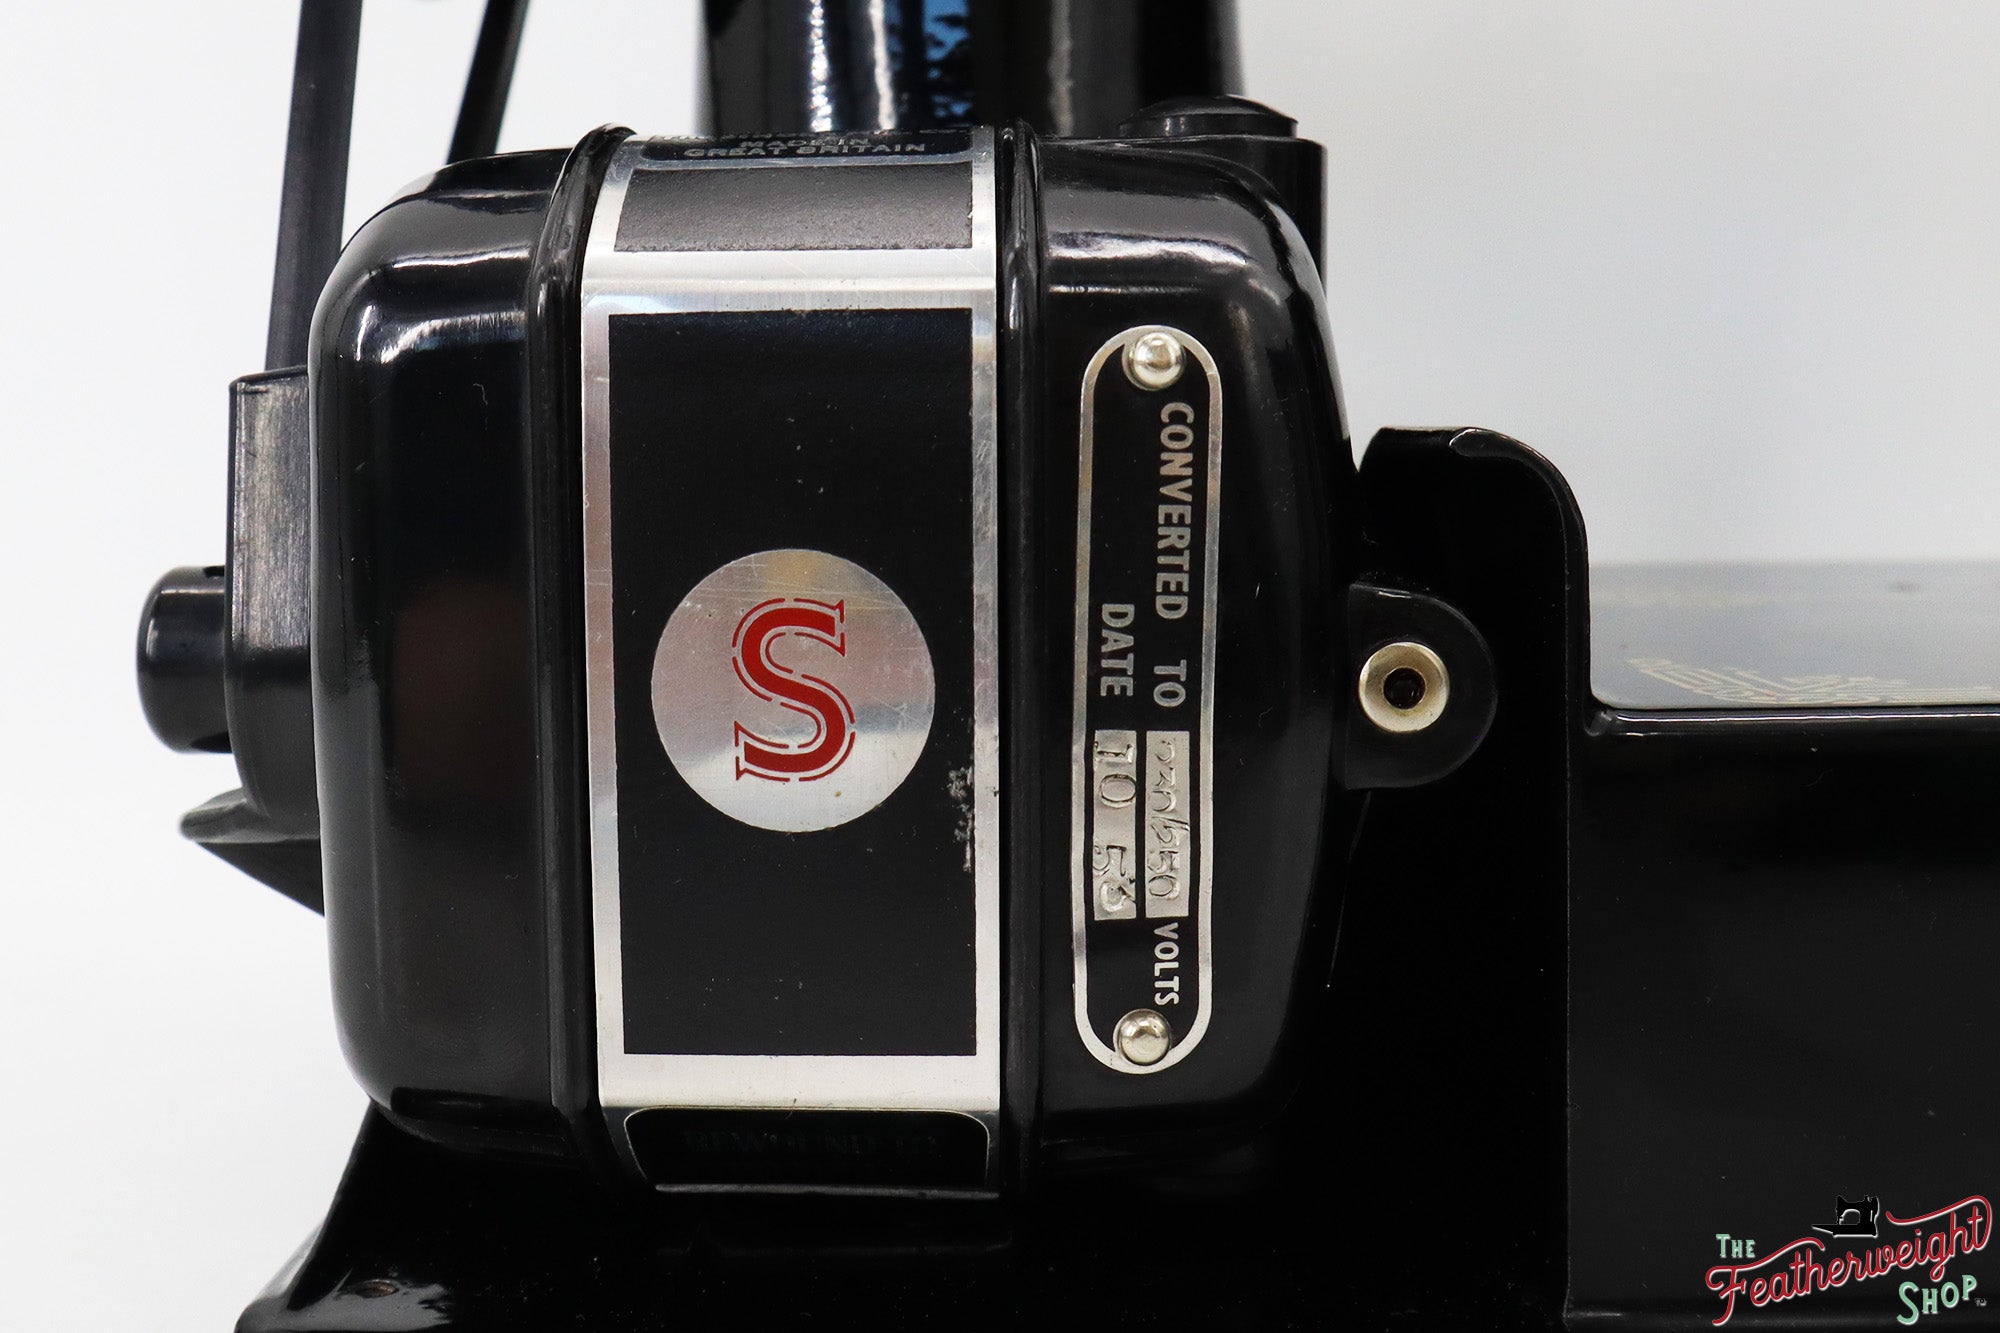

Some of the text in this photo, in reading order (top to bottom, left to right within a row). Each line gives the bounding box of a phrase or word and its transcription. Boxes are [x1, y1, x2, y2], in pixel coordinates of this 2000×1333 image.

[683, 143, 926, 158] GREAT BRITAIN
[838, 137, 870, 146] IN
[1155, 401, 1194, 620] CONVERTED
[732, 598, 856, 783] S
[1100, 603, 1135, 697] DATE
[1153, 658, 1187, 708] TO
[1153, 922, 1180, 1006] VOLTS
